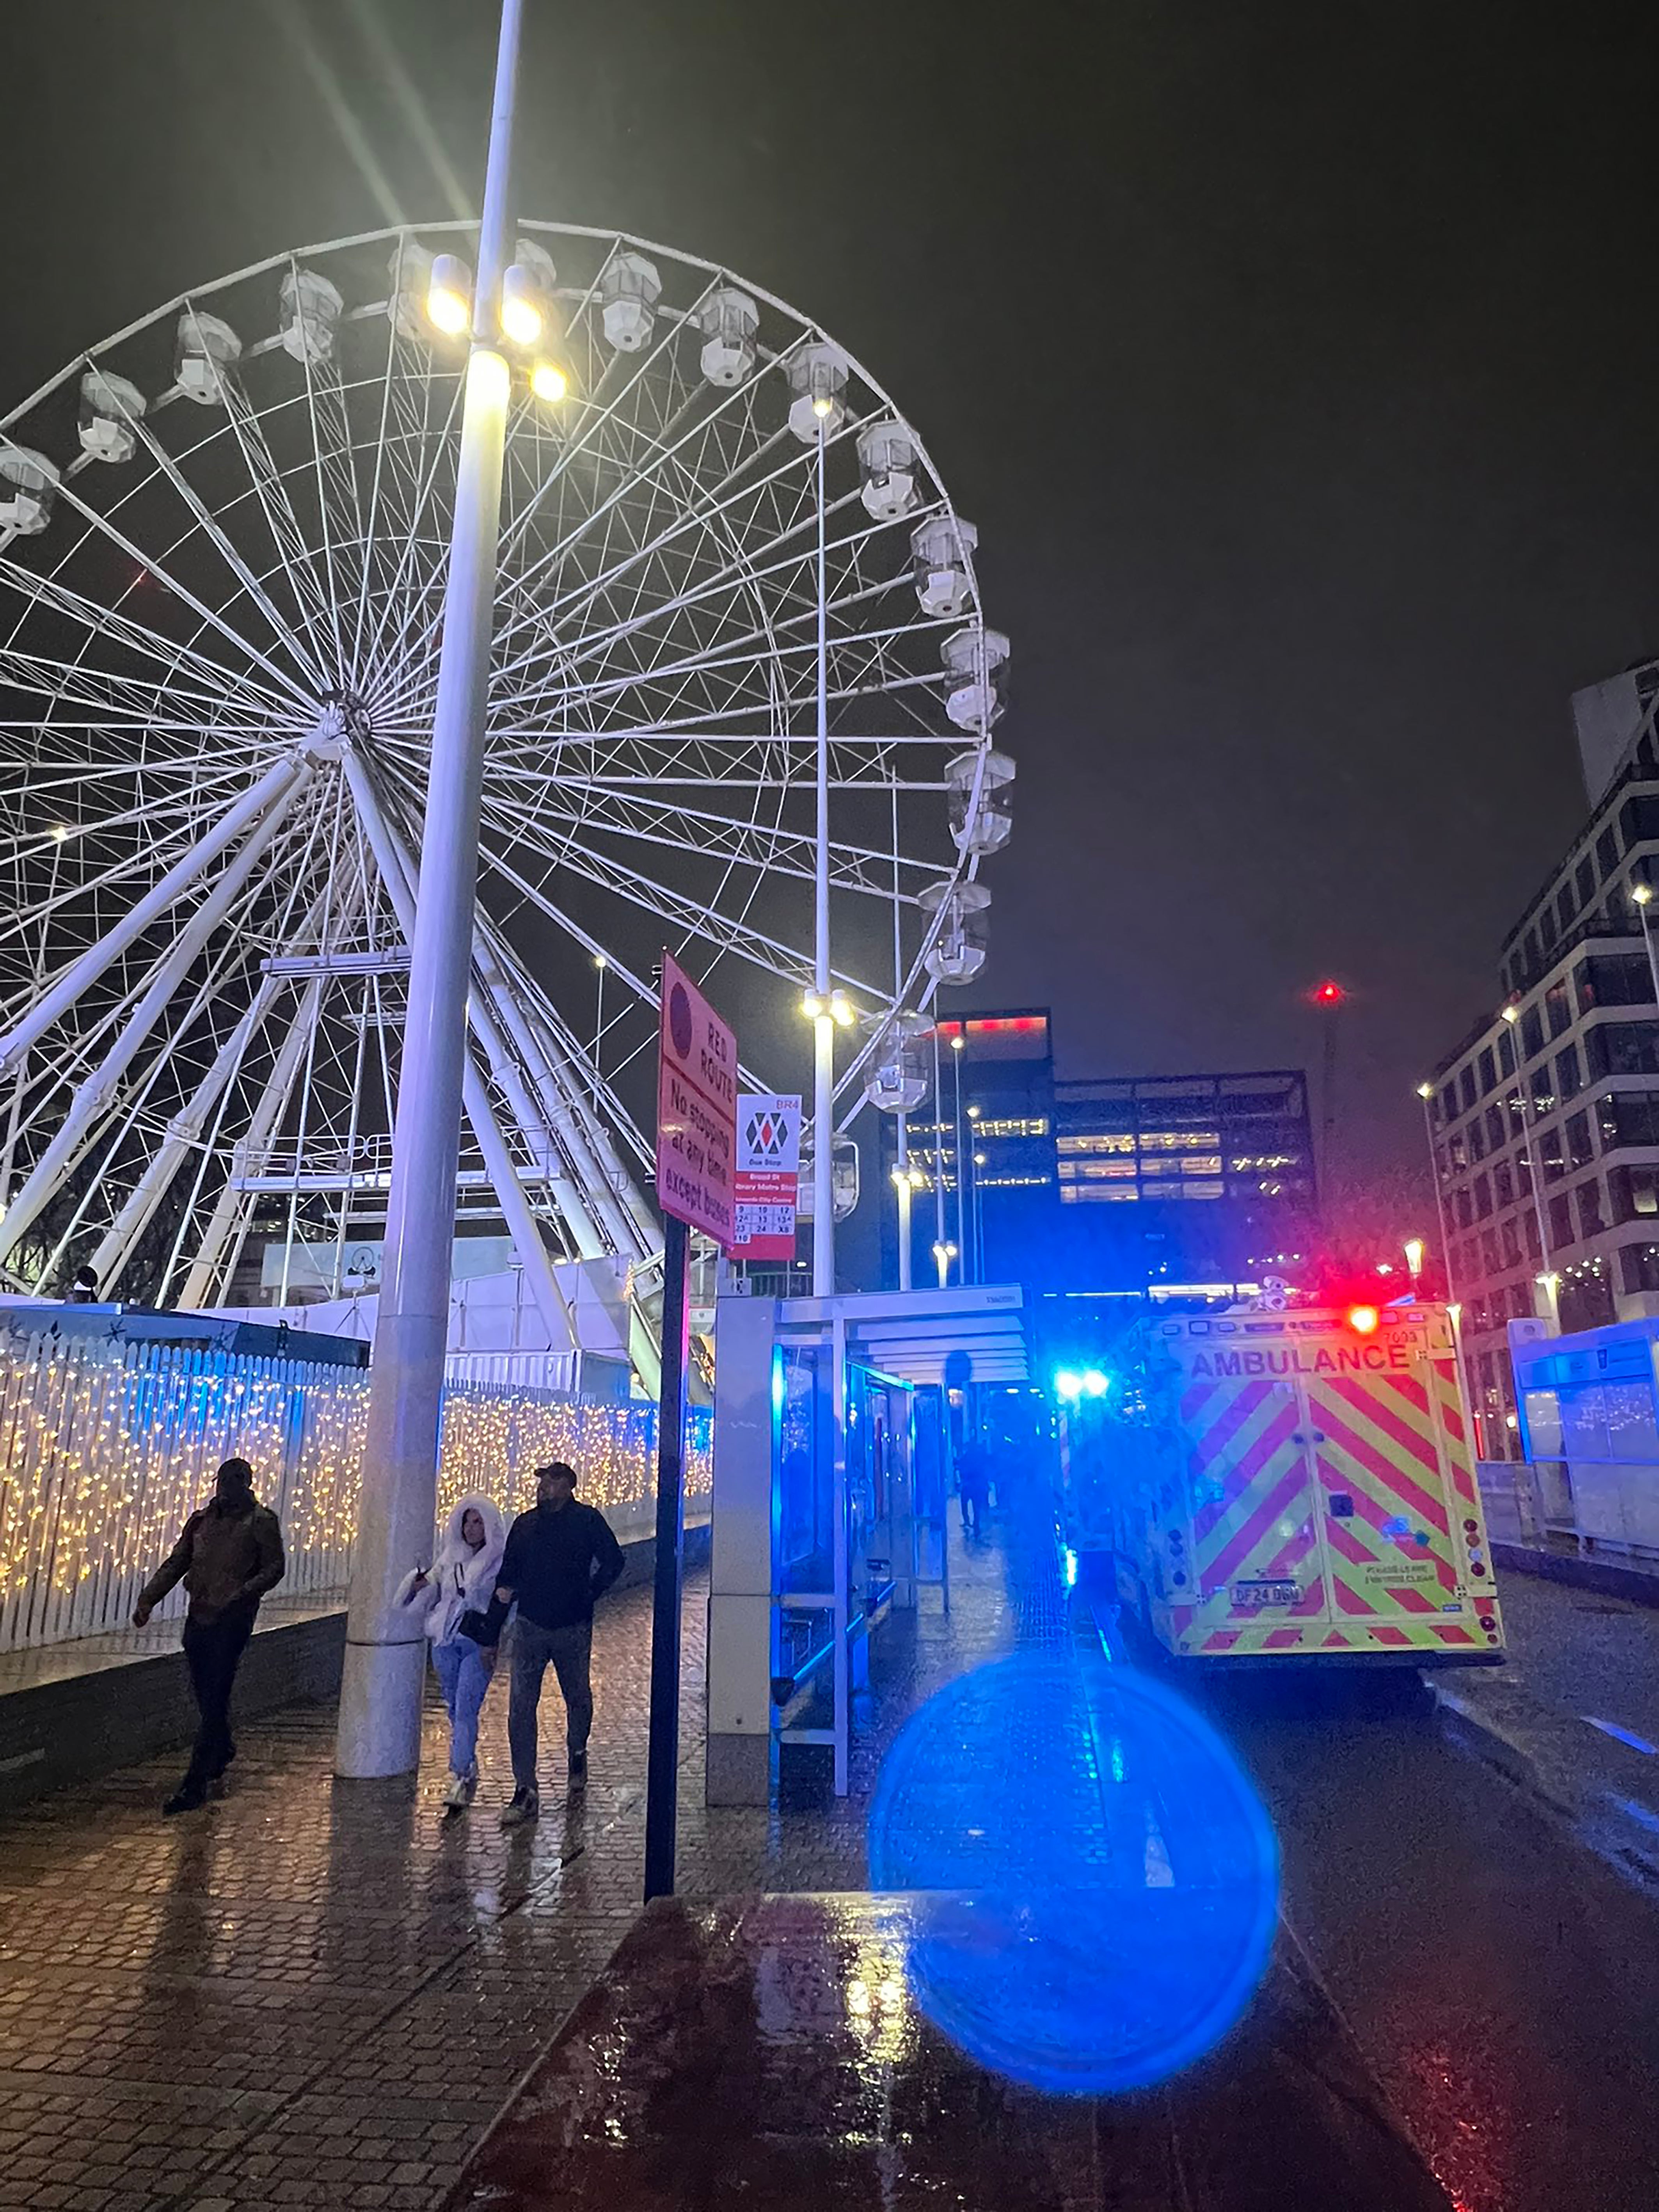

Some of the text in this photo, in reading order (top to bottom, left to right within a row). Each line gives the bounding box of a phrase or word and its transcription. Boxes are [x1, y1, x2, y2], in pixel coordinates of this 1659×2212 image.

[708, 1022, 727, 1063] RED
[701, 1048, 732, 1104] ROUTE
[671, 1078, 729, 1159] No stopping
[776, 1100, 798, 1109] BR4
[672, 1133, 727, 1187] at any time
[666, 1168, 730, 1227] except buses
[1191, 1343, 1410, 1379] AMBULANCE
